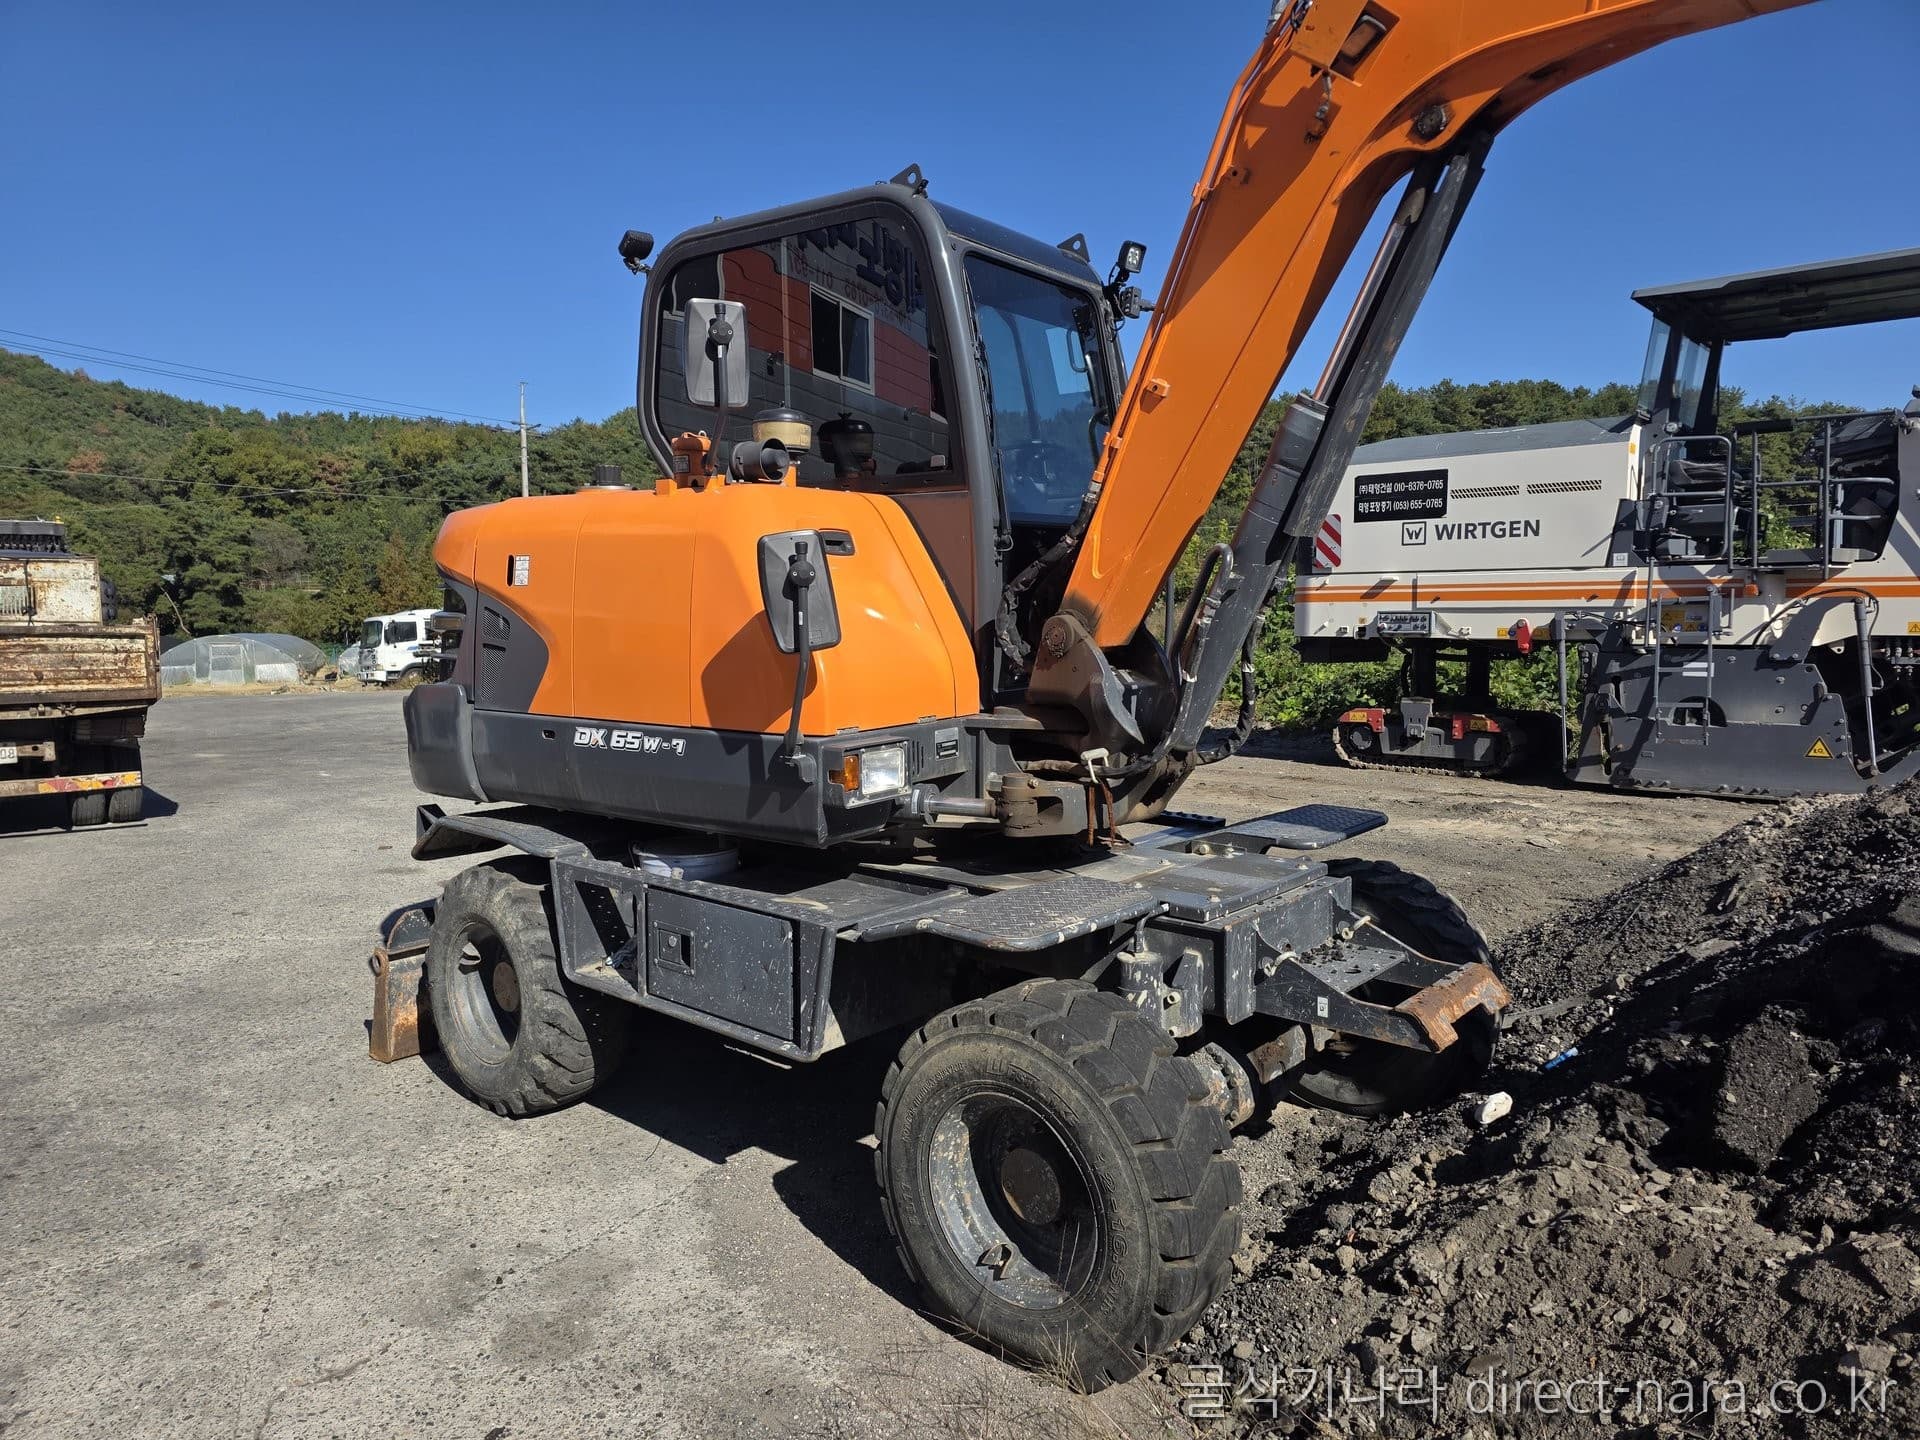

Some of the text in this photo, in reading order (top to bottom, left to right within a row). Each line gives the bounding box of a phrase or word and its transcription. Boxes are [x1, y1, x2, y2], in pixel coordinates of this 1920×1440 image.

[1393, 500, 1410, 511] (053)
[1434, 519, 1540, 541] WIRTGEN
[573, 726, 608, 749] DX
